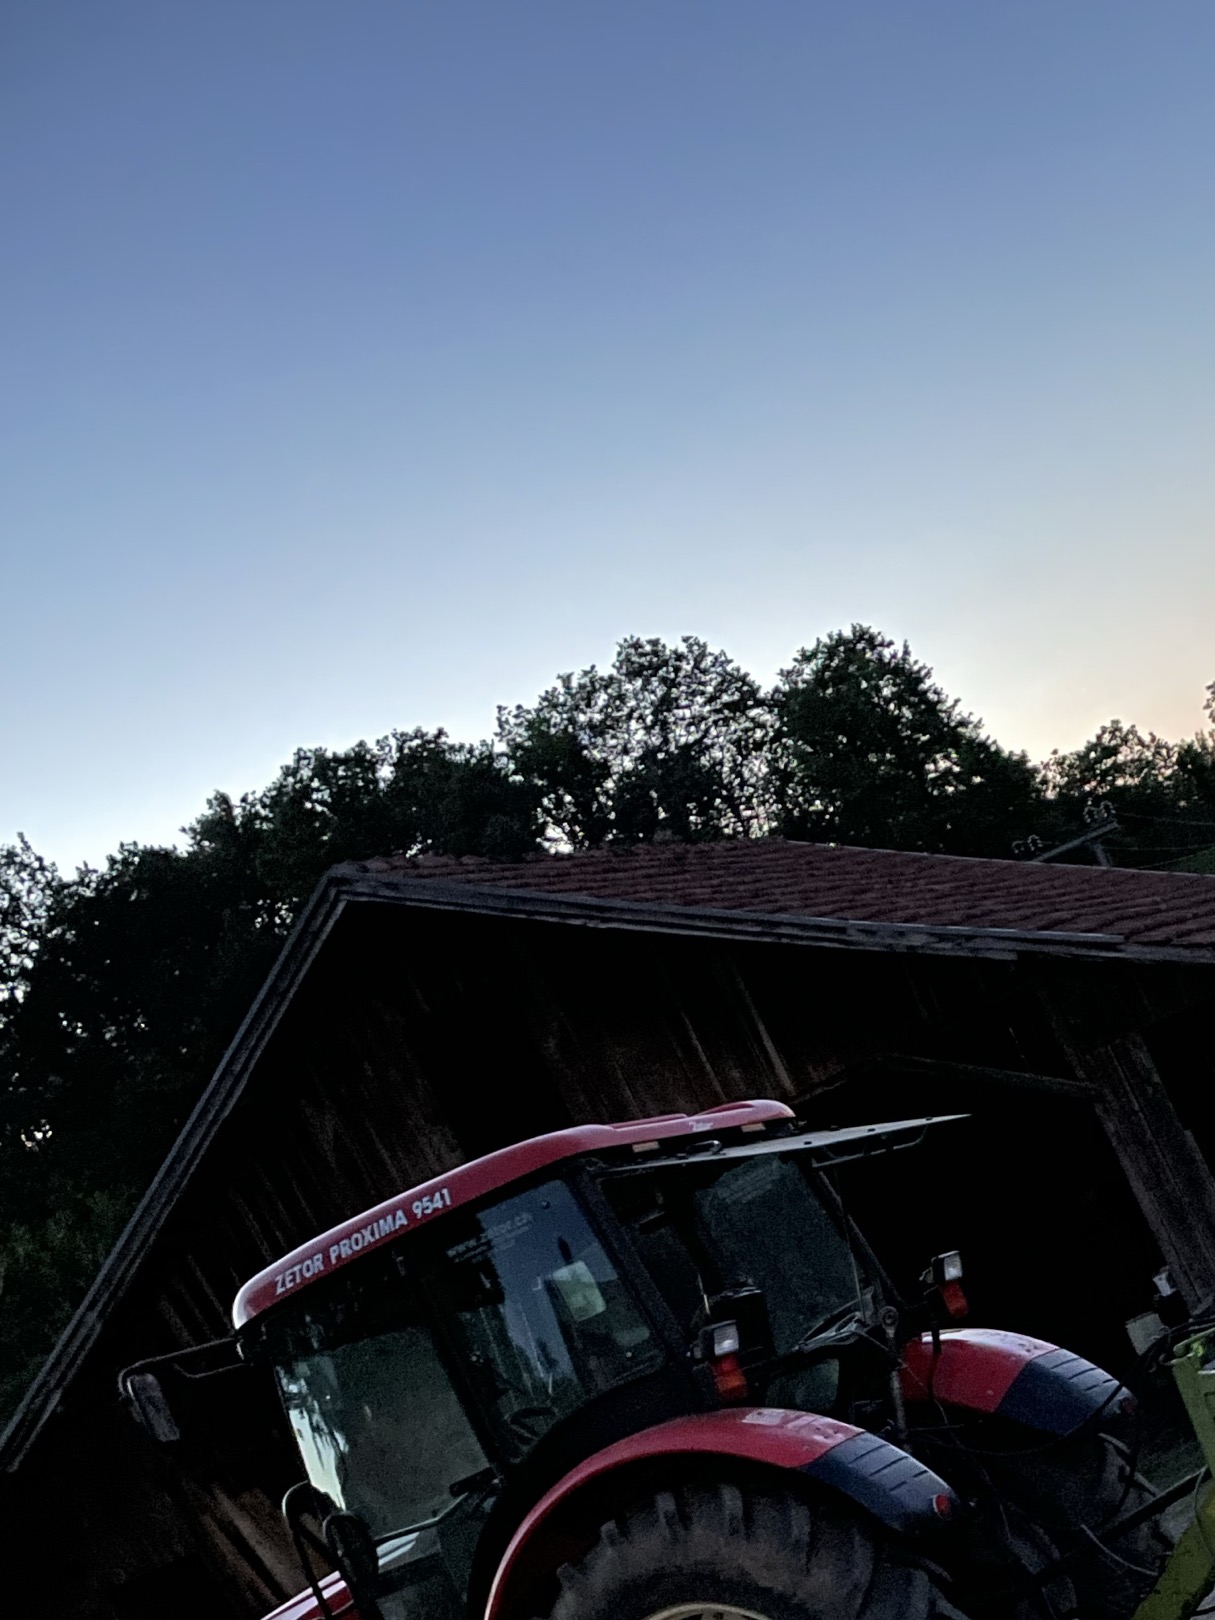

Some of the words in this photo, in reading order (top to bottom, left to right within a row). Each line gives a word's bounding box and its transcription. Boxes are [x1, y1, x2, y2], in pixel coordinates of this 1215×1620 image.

[274, 1252, 325, 1296] ZETOR
[328, 1209, 409, 1265] PROXIMA
[411, 1188, 452, 1220] 9541
